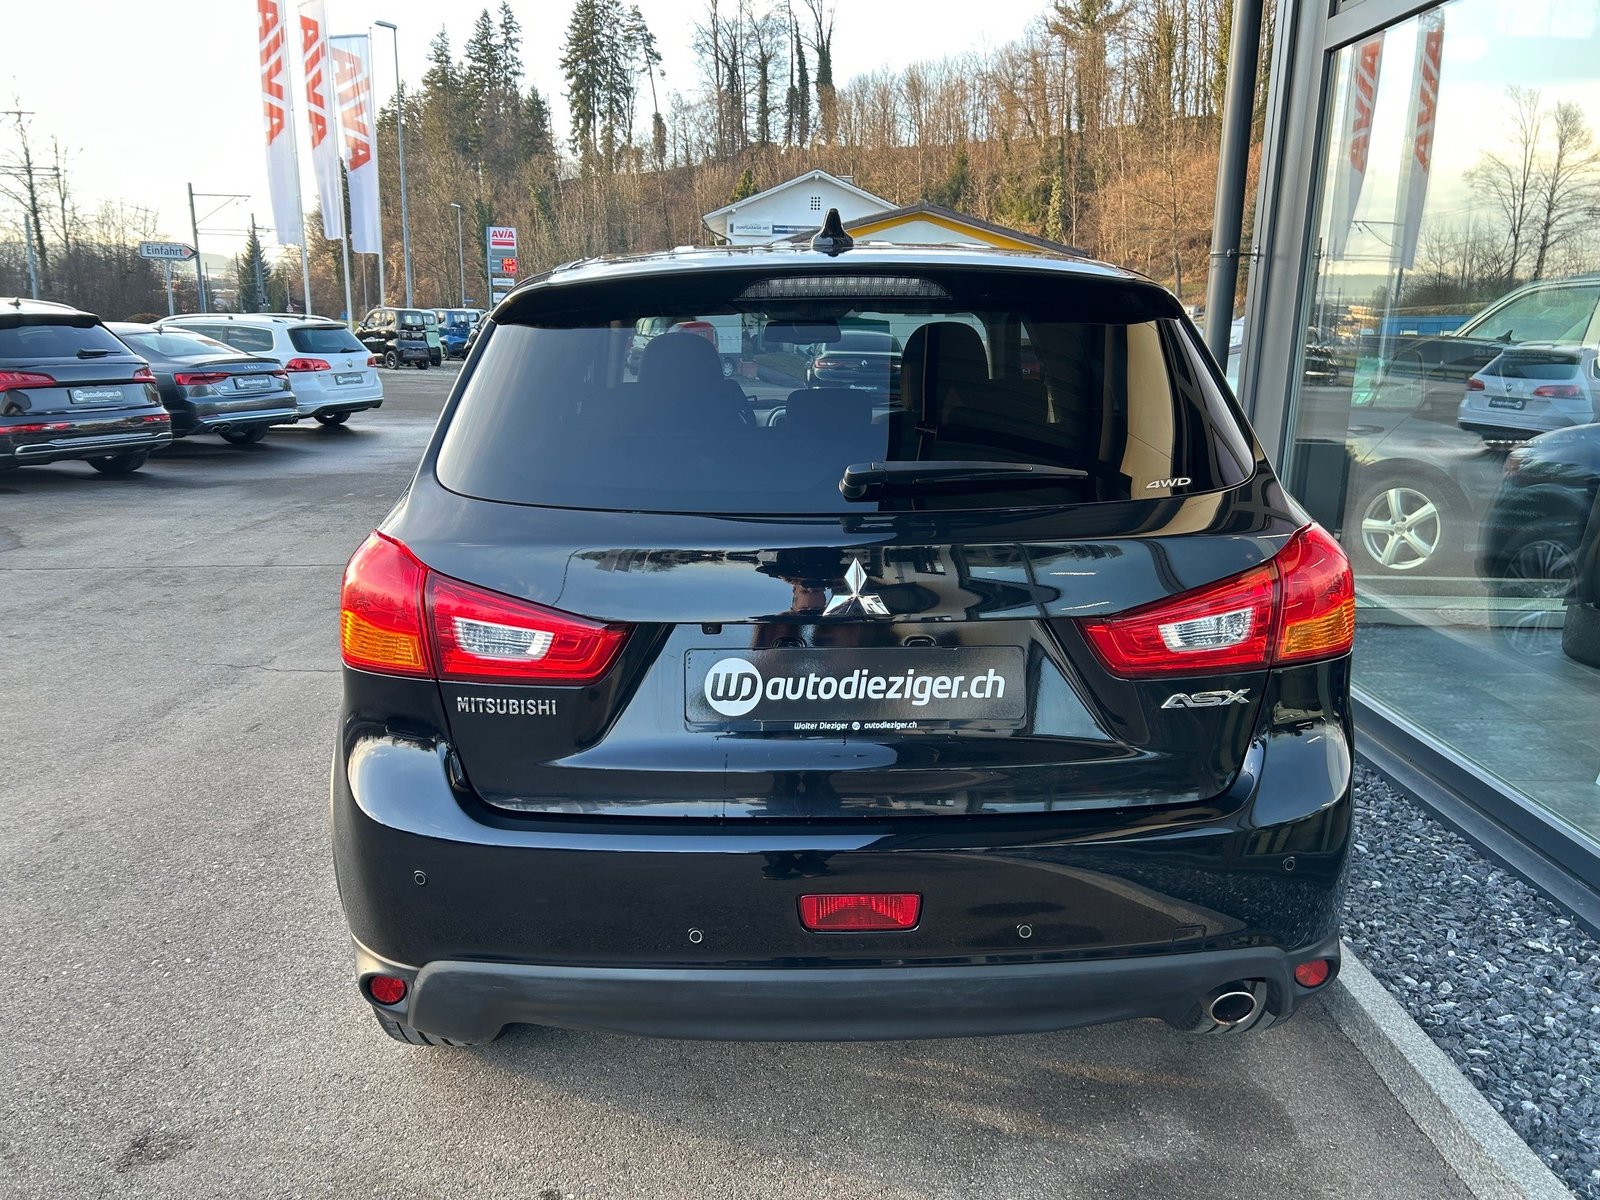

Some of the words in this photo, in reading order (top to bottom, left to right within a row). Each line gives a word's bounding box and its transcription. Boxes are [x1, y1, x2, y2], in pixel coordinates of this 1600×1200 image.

[492, 229, 514, 238] AVIA
[146, 245, 183, 256] Einfahrt
[1145, 477, 1191, 489] 4WD
[765, 668, 1006, 706] autodieziger.ch
[1161, 688, 1251, 709] ASX
[457, 696, 557, 715] MITSUBISHI
[794, 721, 818, 730] Walter
[819, 721, 848, 731] Dieziger
[864, 721, 918, 730] autodieziger.ch
